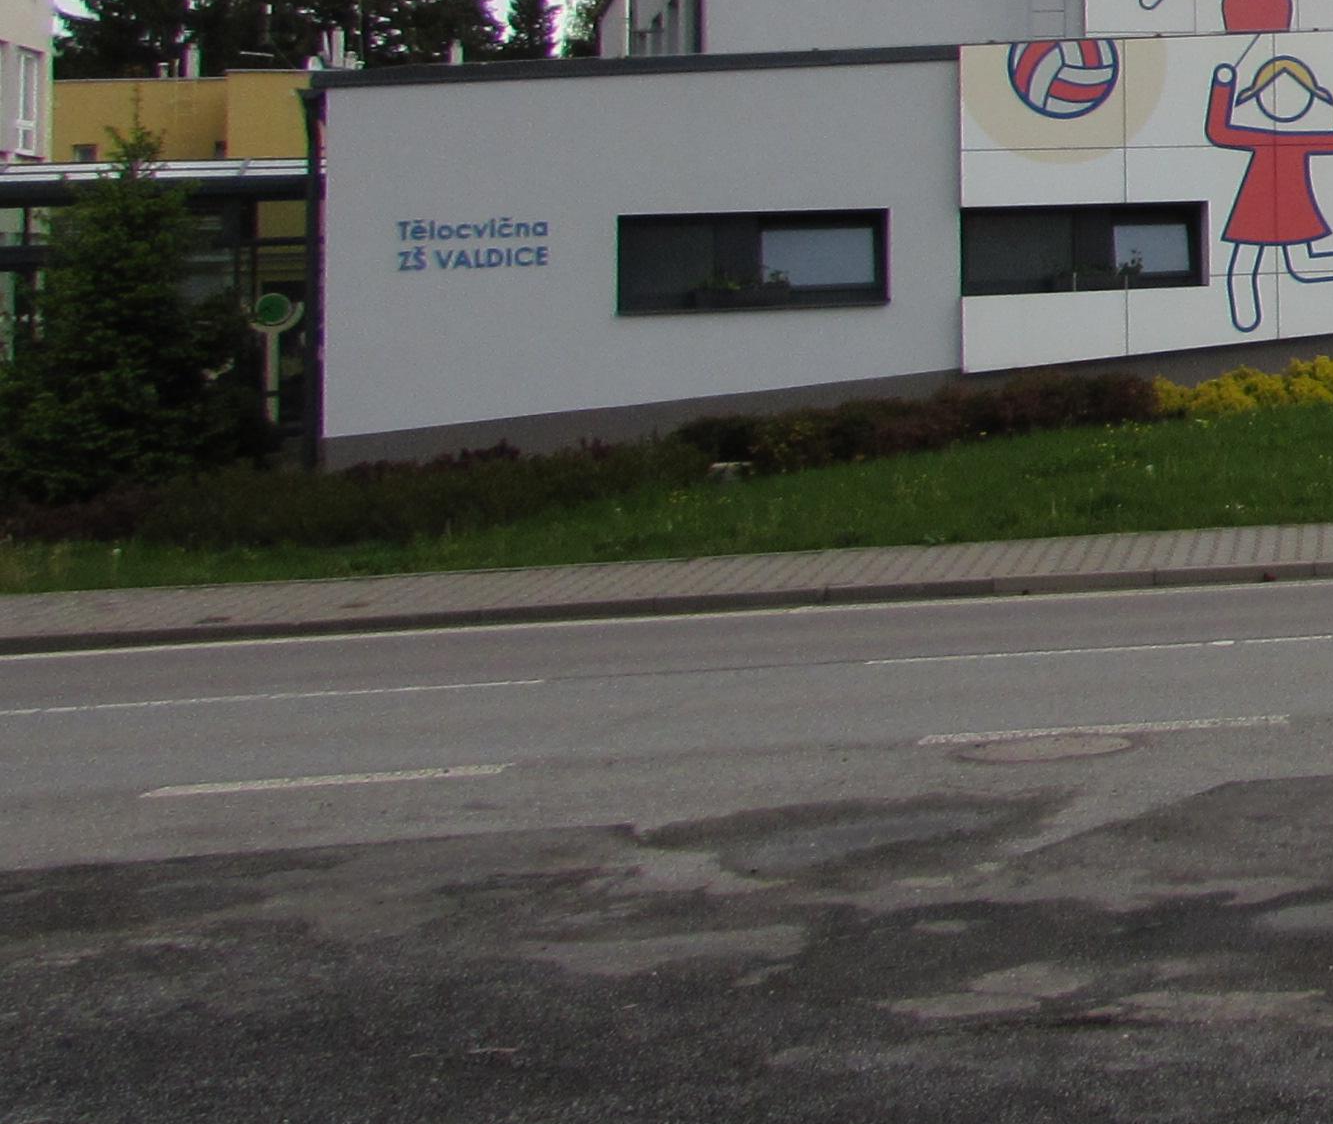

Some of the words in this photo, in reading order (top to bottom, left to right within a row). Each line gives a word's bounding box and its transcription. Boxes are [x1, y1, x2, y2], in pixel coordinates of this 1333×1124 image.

[398, 217, 549, 240] Tělocvična
[398, 246, 428, 270] ZŠ
[435, 246, 549, 269] VALDICE
